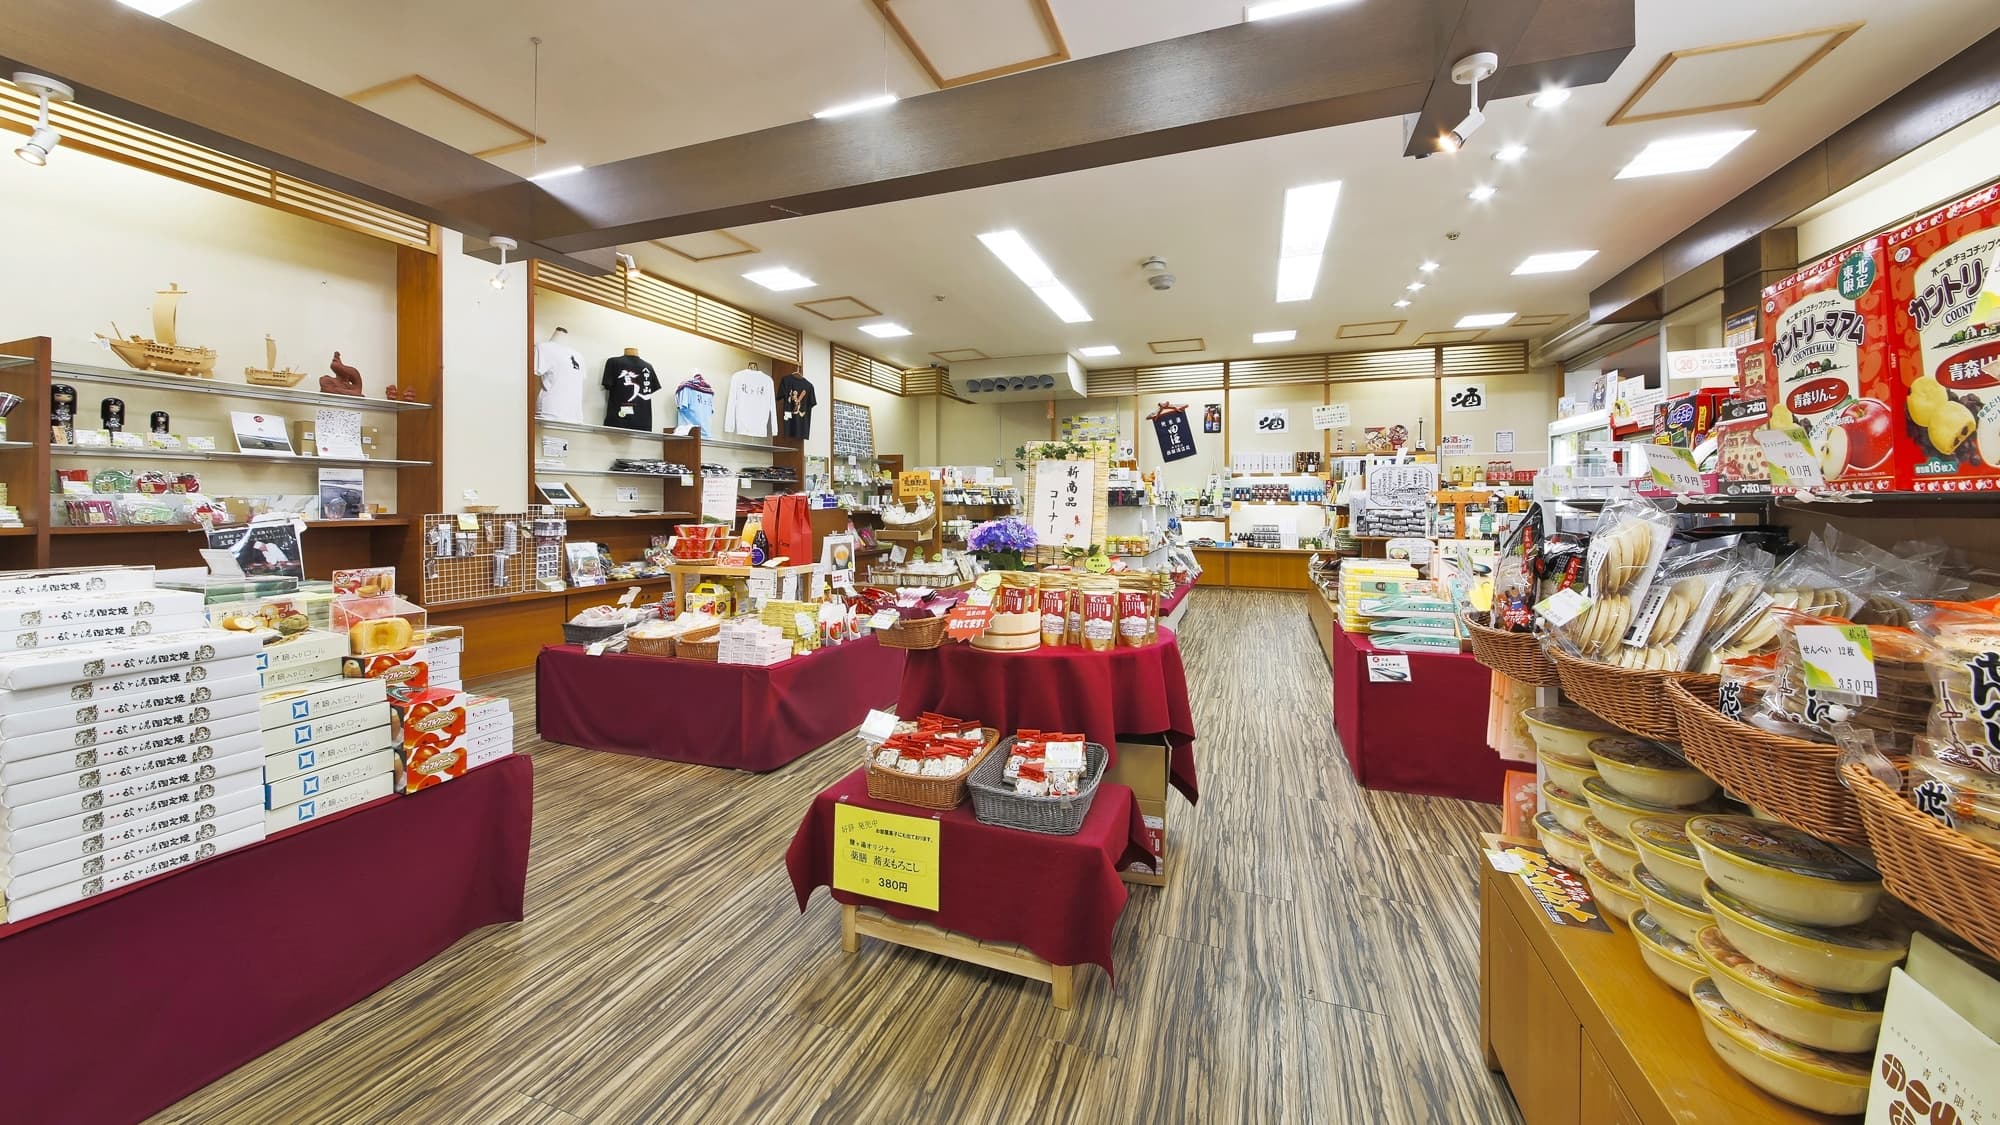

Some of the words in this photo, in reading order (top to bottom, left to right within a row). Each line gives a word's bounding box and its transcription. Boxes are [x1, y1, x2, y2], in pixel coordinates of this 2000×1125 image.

[1910, 259, 1986, 329] カントリ
[1945, 301, 1977, 324] COUNT
[1773, 311, 1865, 366] カントリーマアム
[1794, 385, 1839, 408] 青森りんご
[1065, 466, 1079, 507] 新商品
[1048, 490, 1059, 535] コーナー
[1803, 645, 1832, 654] せんべい
[1838, 646, 1855, 656] 12枚
[1839, 679, 1873, 695] 350円
[873, 855, 920, 873] 蕎麦もろこし
[878, 877, 908, 893] 380円
